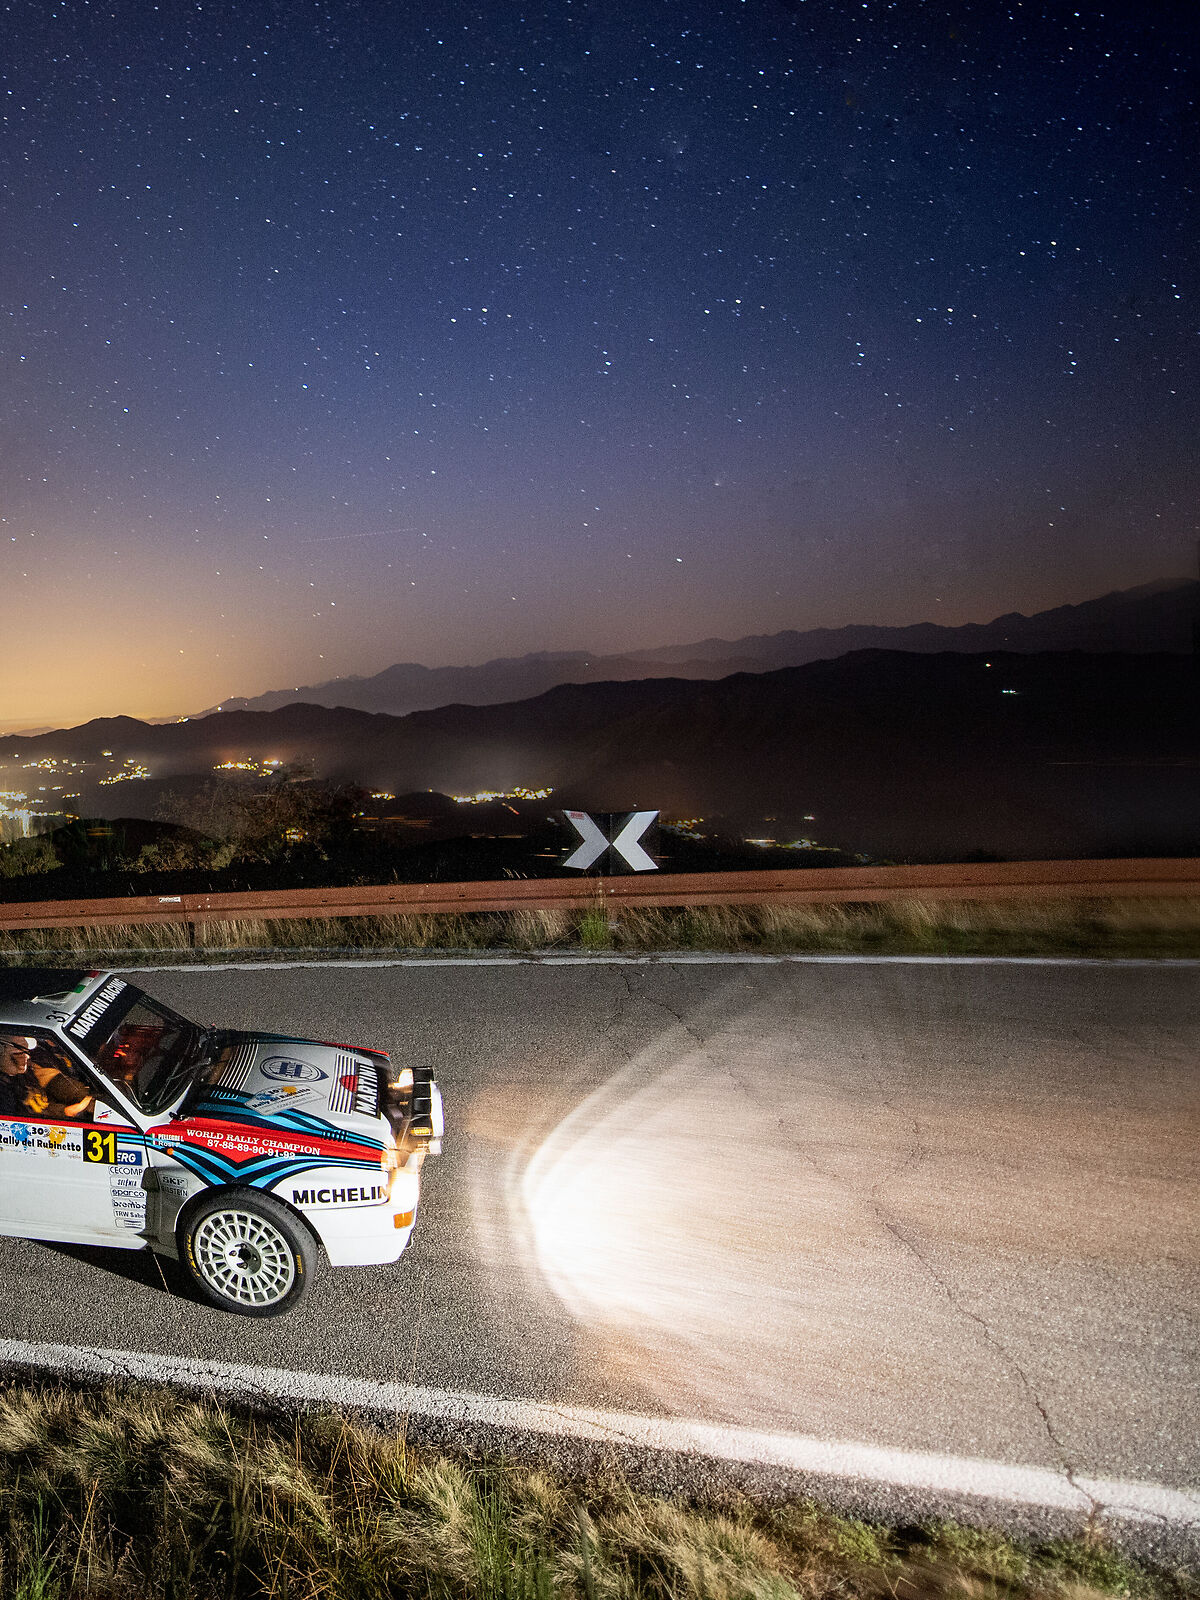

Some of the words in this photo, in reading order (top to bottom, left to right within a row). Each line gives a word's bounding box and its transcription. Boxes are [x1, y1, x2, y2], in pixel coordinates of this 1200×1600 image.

[46, 1009, 71, 1023] 31
[69, 997, 110, 1039] MARTINI
[99, 978, 128, 1003] RACING
[355, 1064, 378, 1116] MARTINI
[21, 1137, 35, 1147] del
[37, 1139, 82, 1152] Rubinetto
[87, 1131, 115, 1164] 31
[186, 1129, 224, 1140] WORLD
[225, 1134, 260, 1145] RALLY
[262, 1139, 321, 1156] CHAMPION
[207, 1139, 296, 1160] 87-88-89-90-91-92
[109, 1166, 143, 1176] CECOMP
[162, 1176, 185, 1186] SKF
[112, 1188, 145, 1197] sparco
[292, 1186, 388, 1204] MICHELIN
[112, 1200, 147, 1210] brembo
